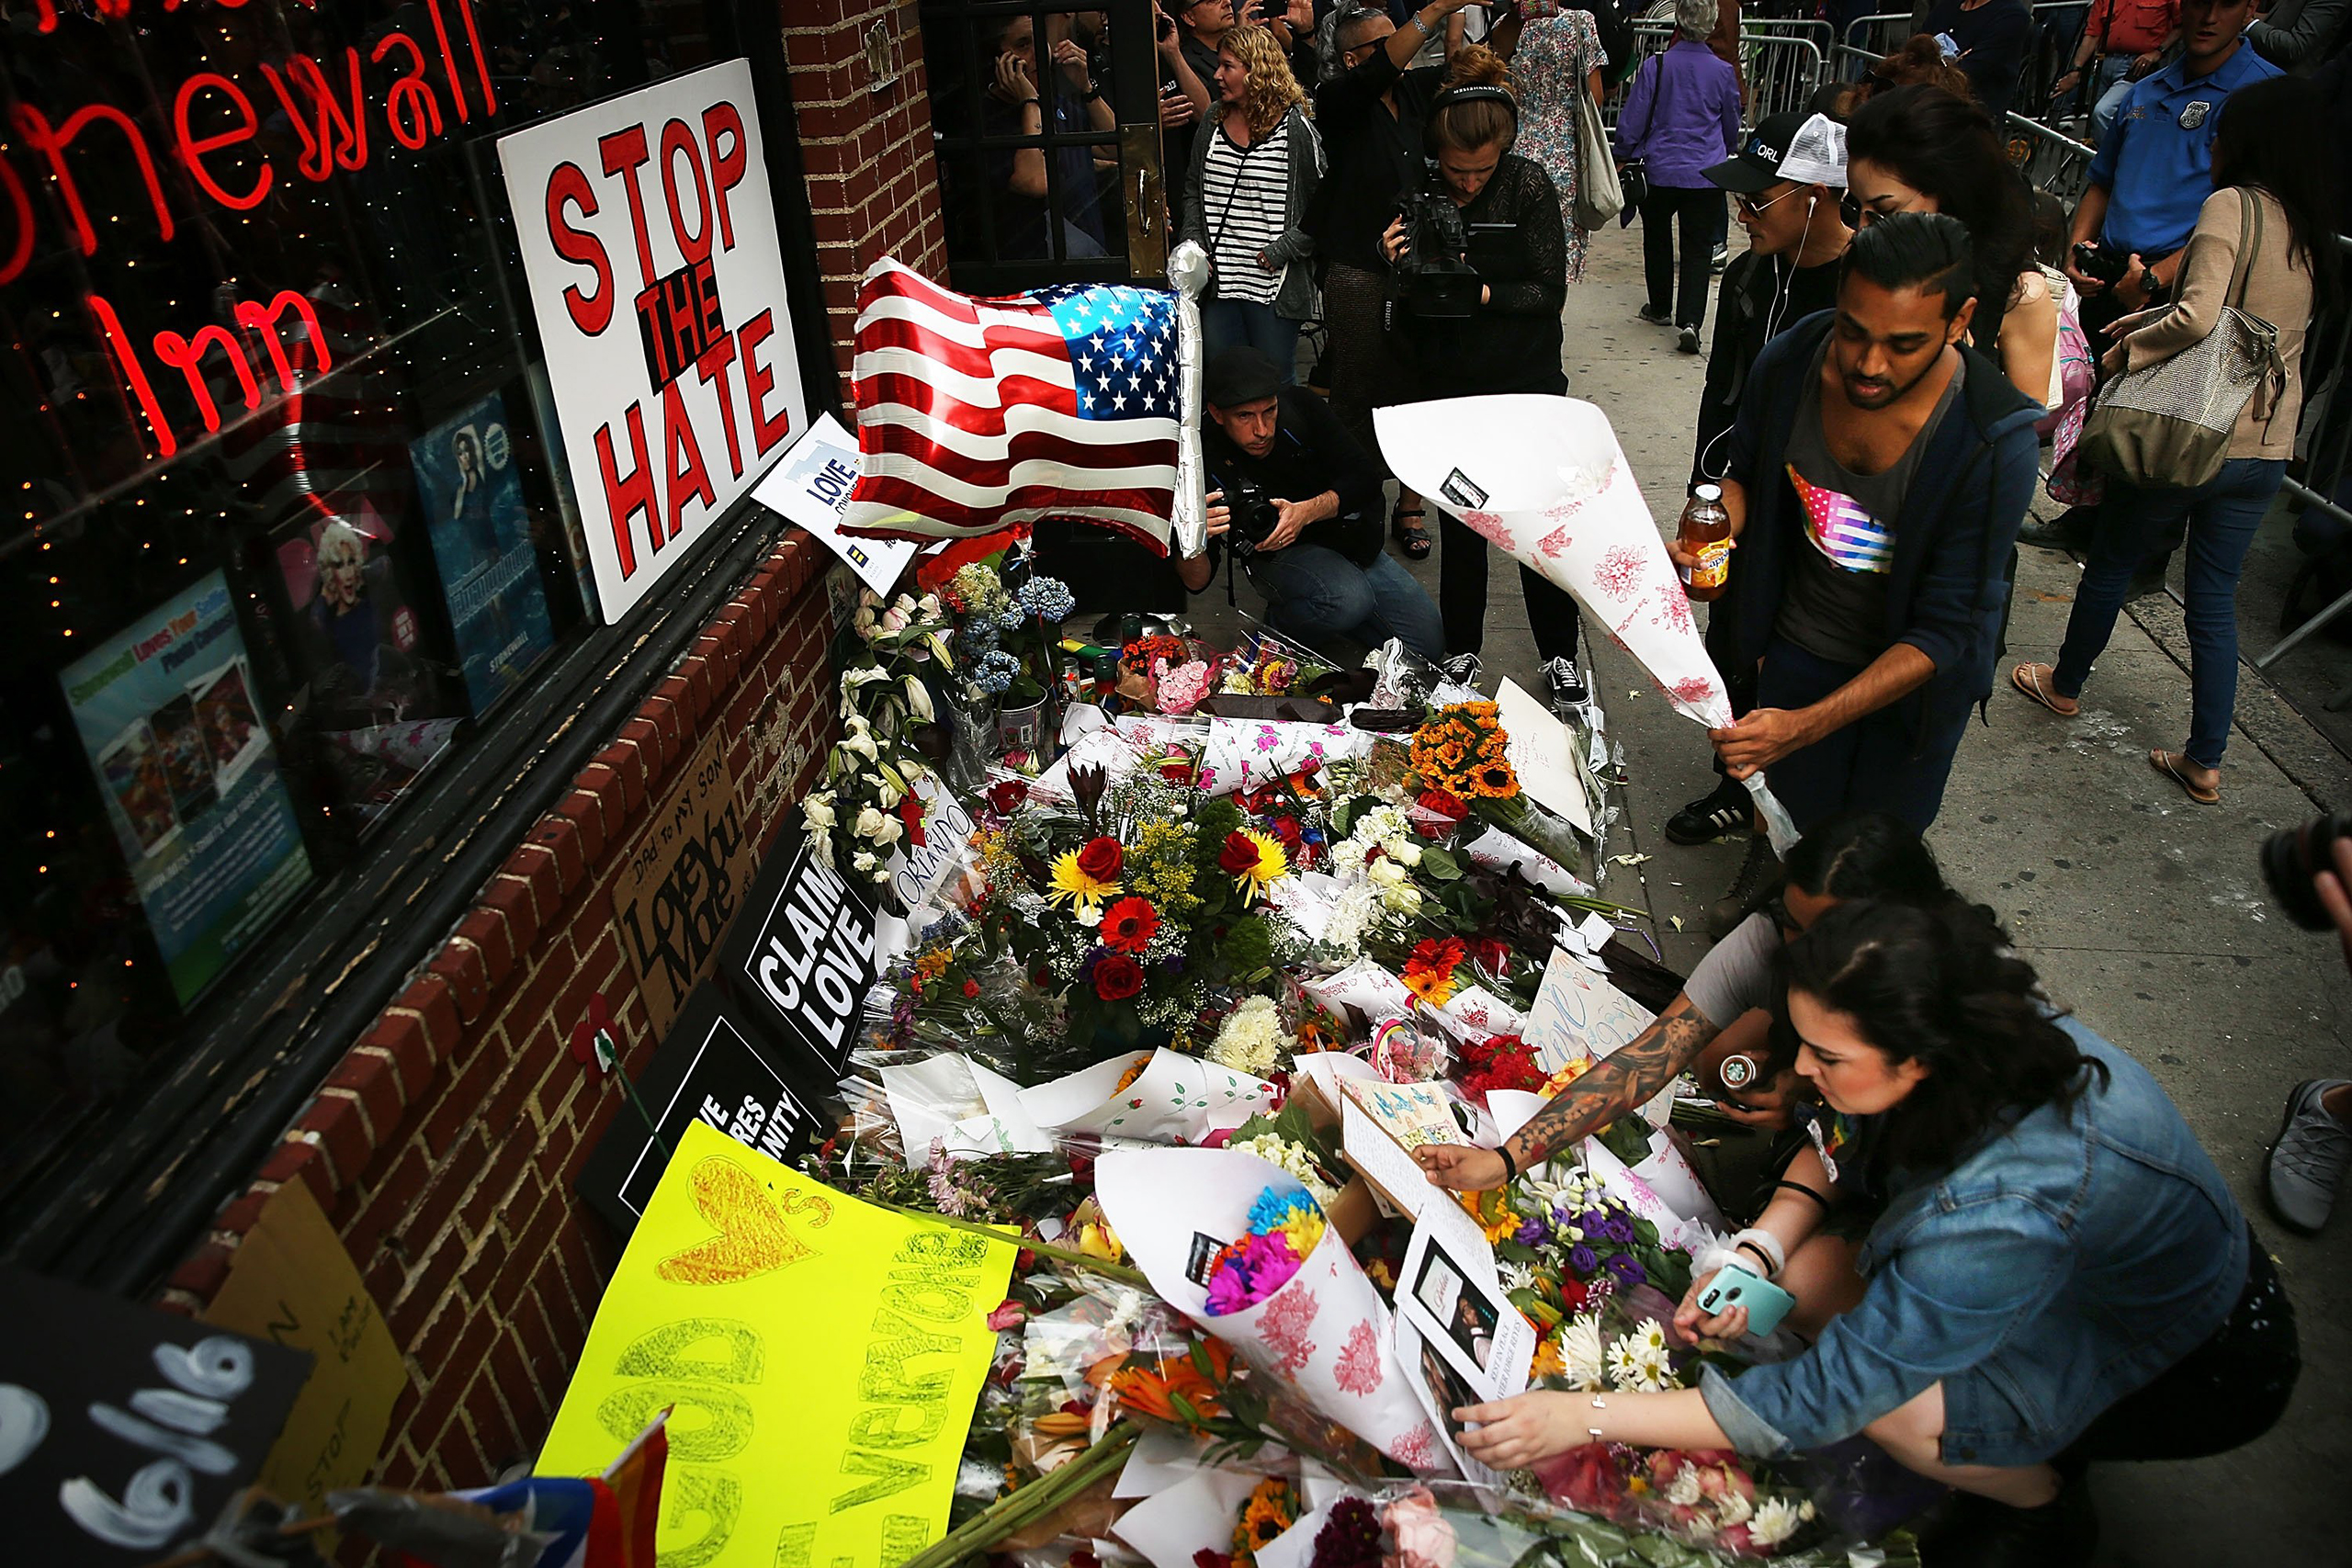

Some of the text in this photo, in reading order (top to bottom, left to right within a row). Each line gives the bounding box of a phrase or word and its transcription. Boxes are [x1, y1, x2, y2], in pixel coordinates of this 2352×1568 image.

[0, 0, 497, 281] newall
[1757, 144, 1779, 164] ORL
[545, 100, 747, 336] STOP
[86, 290, 332, 457] Inn
[635, 259, 726, 395] THE
[594, 308, 790, 582] HATE
[806, 458, 856, 506] LOVE
[674, 789, 694, 835] MY
[698, 739, 722, 798] SON
[896, 804, 971, 906] ORLANDO
[758, 853, 847, 1011] CLAIM
[800, 904, 877, 1051] LOVE
[1502, 1348, 1516, 1377] JORGE
[1510, 1319, 1522, 1348] REYES
